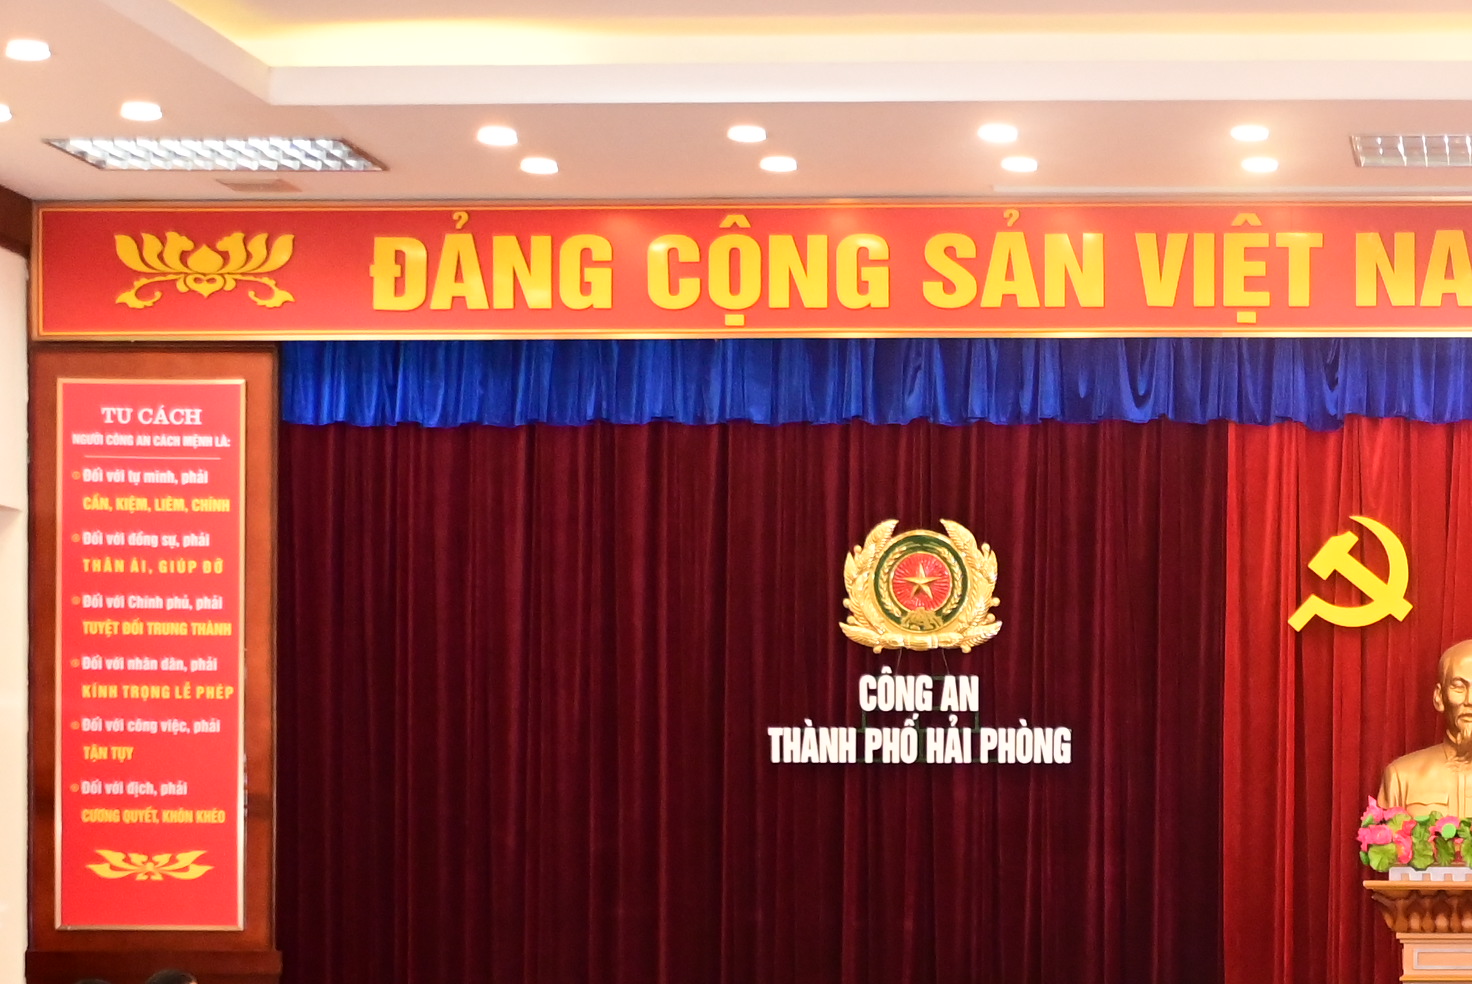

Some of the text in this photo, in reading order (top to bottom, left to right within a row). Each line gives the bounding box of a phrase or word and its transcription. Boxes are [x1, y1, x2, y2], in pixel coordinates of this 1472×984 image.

[369, 211, 613, 310] ĐẢNG
[647, 213, 890, 326] CỘNG
[922, 208, 1105, 310] SẢN
[1134, 212, 1323, 323] VIỆT
[139, 406, 202, 425] CÁCH
[107, 432, 134, 446] CÔNG
[137, 435, 151, 447] AN
[154, 434, 180, 447] CÁCH
[155, 496, 188, 514] LIÊM,
[192, 497, 231, 513] CHÍNH
[84, 557, 125, 573] THÂN
[159, 558, 197, 574] GIÚP
[148, 622, 188, 636] TRUNG
[83, 683, 118, 699] KÍNH
[123, 686, 170, 702] TRỌNG
[197, 684, 234, 700] PHÉP
[858, 666, 979, 712] CÔNG AN
[767, 713, 1072, 764] THÀNH PHỐ HẢI PHÒNG
